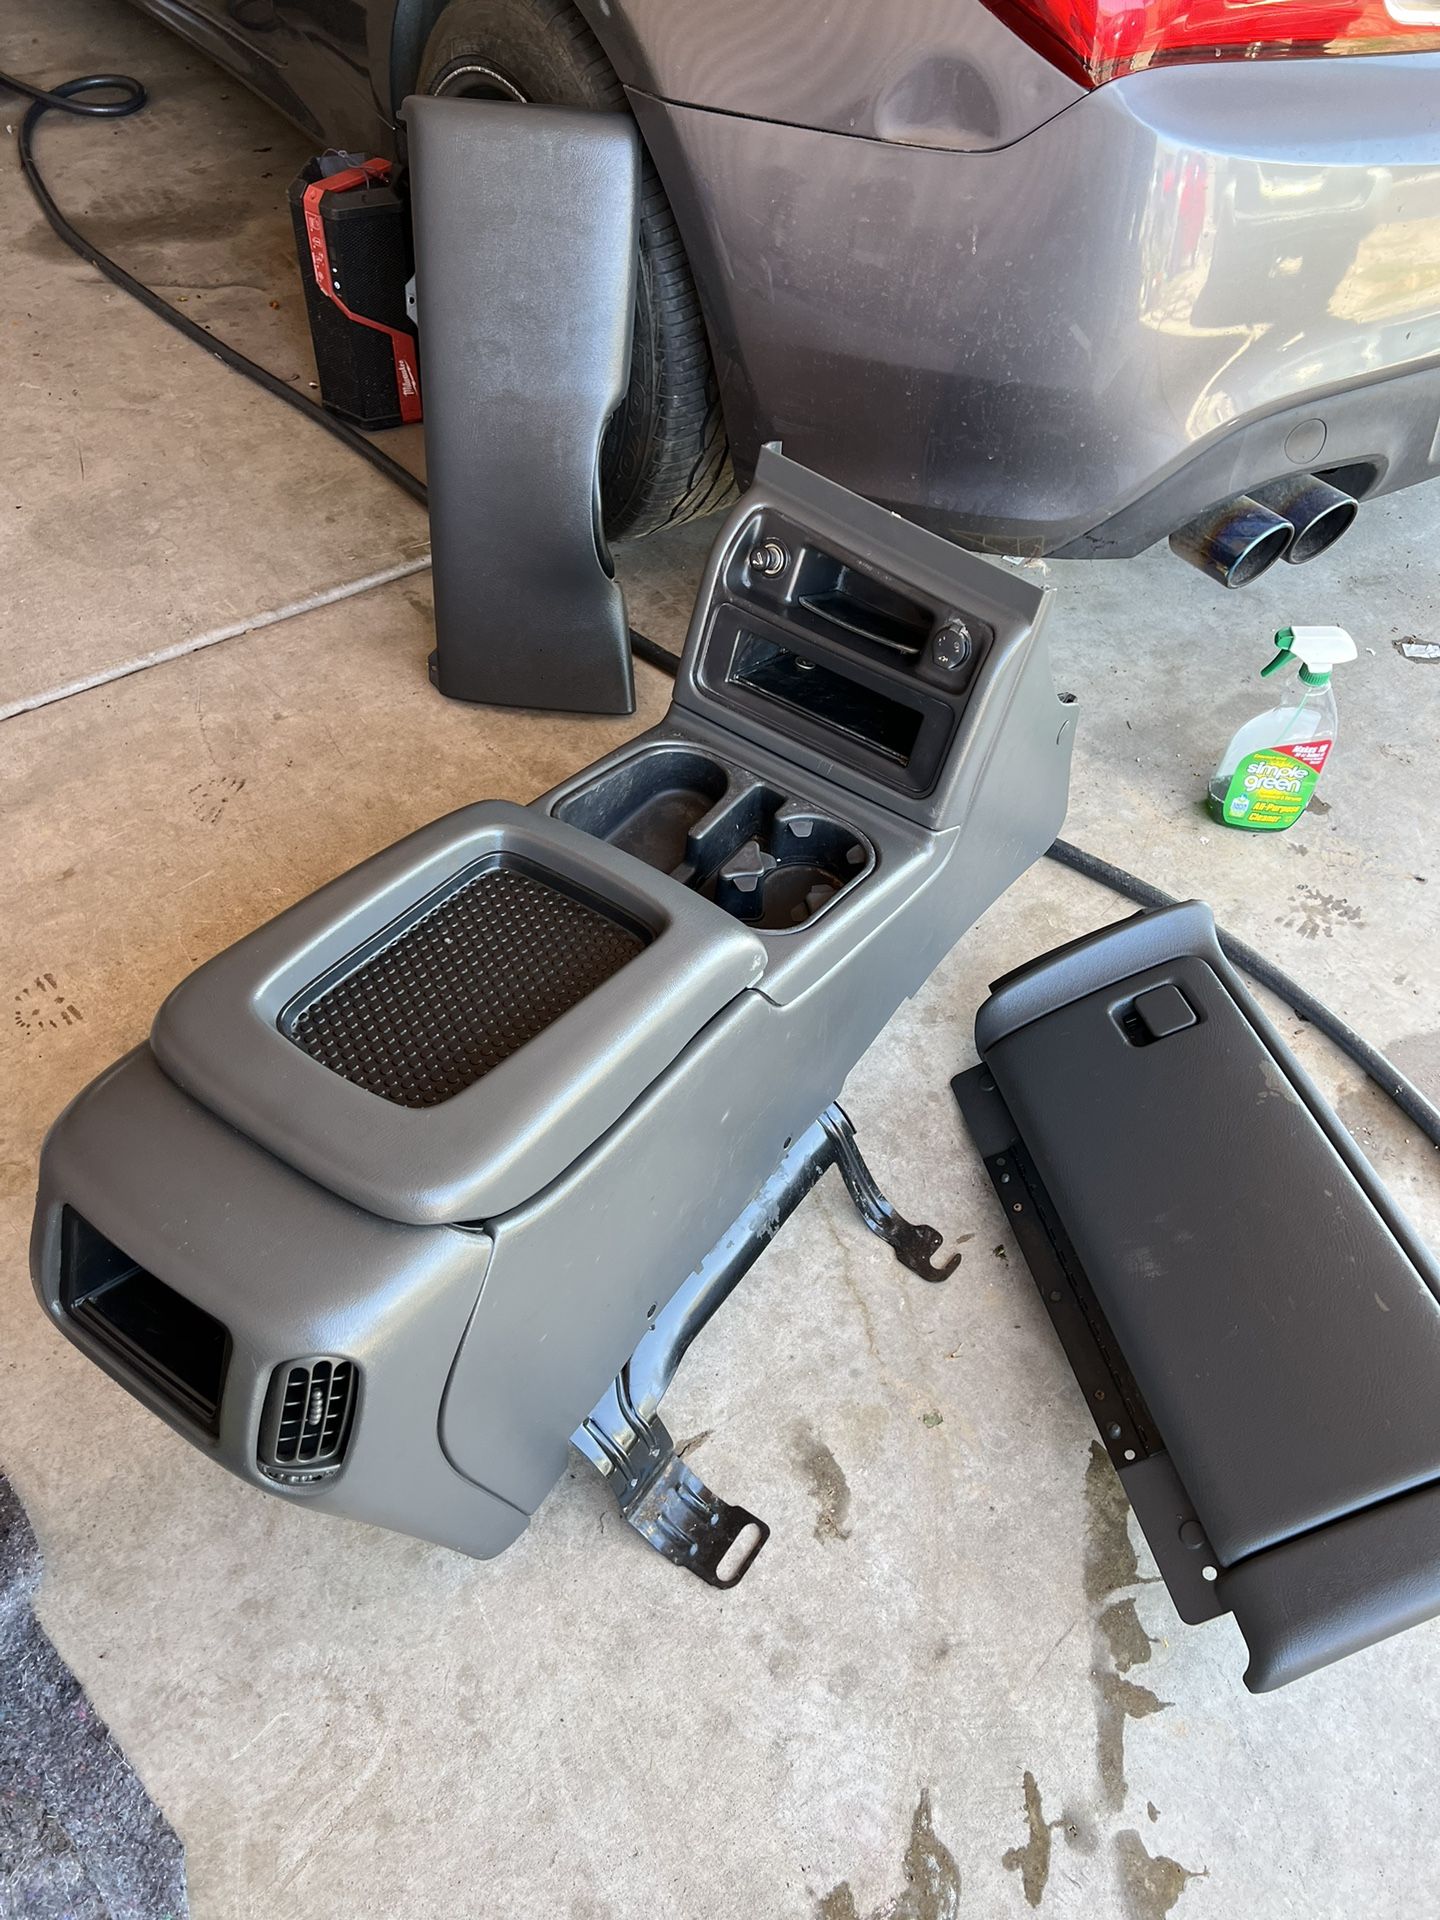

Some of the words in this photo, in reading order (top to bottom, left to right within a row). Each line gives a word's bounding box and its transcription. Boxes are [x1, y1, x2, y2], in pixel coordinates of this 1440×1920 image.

[399, 359, 415, 396] Milwaukee
[1247, 761, 1309, 779] simple
[1244, 775, 1302, 793] green
